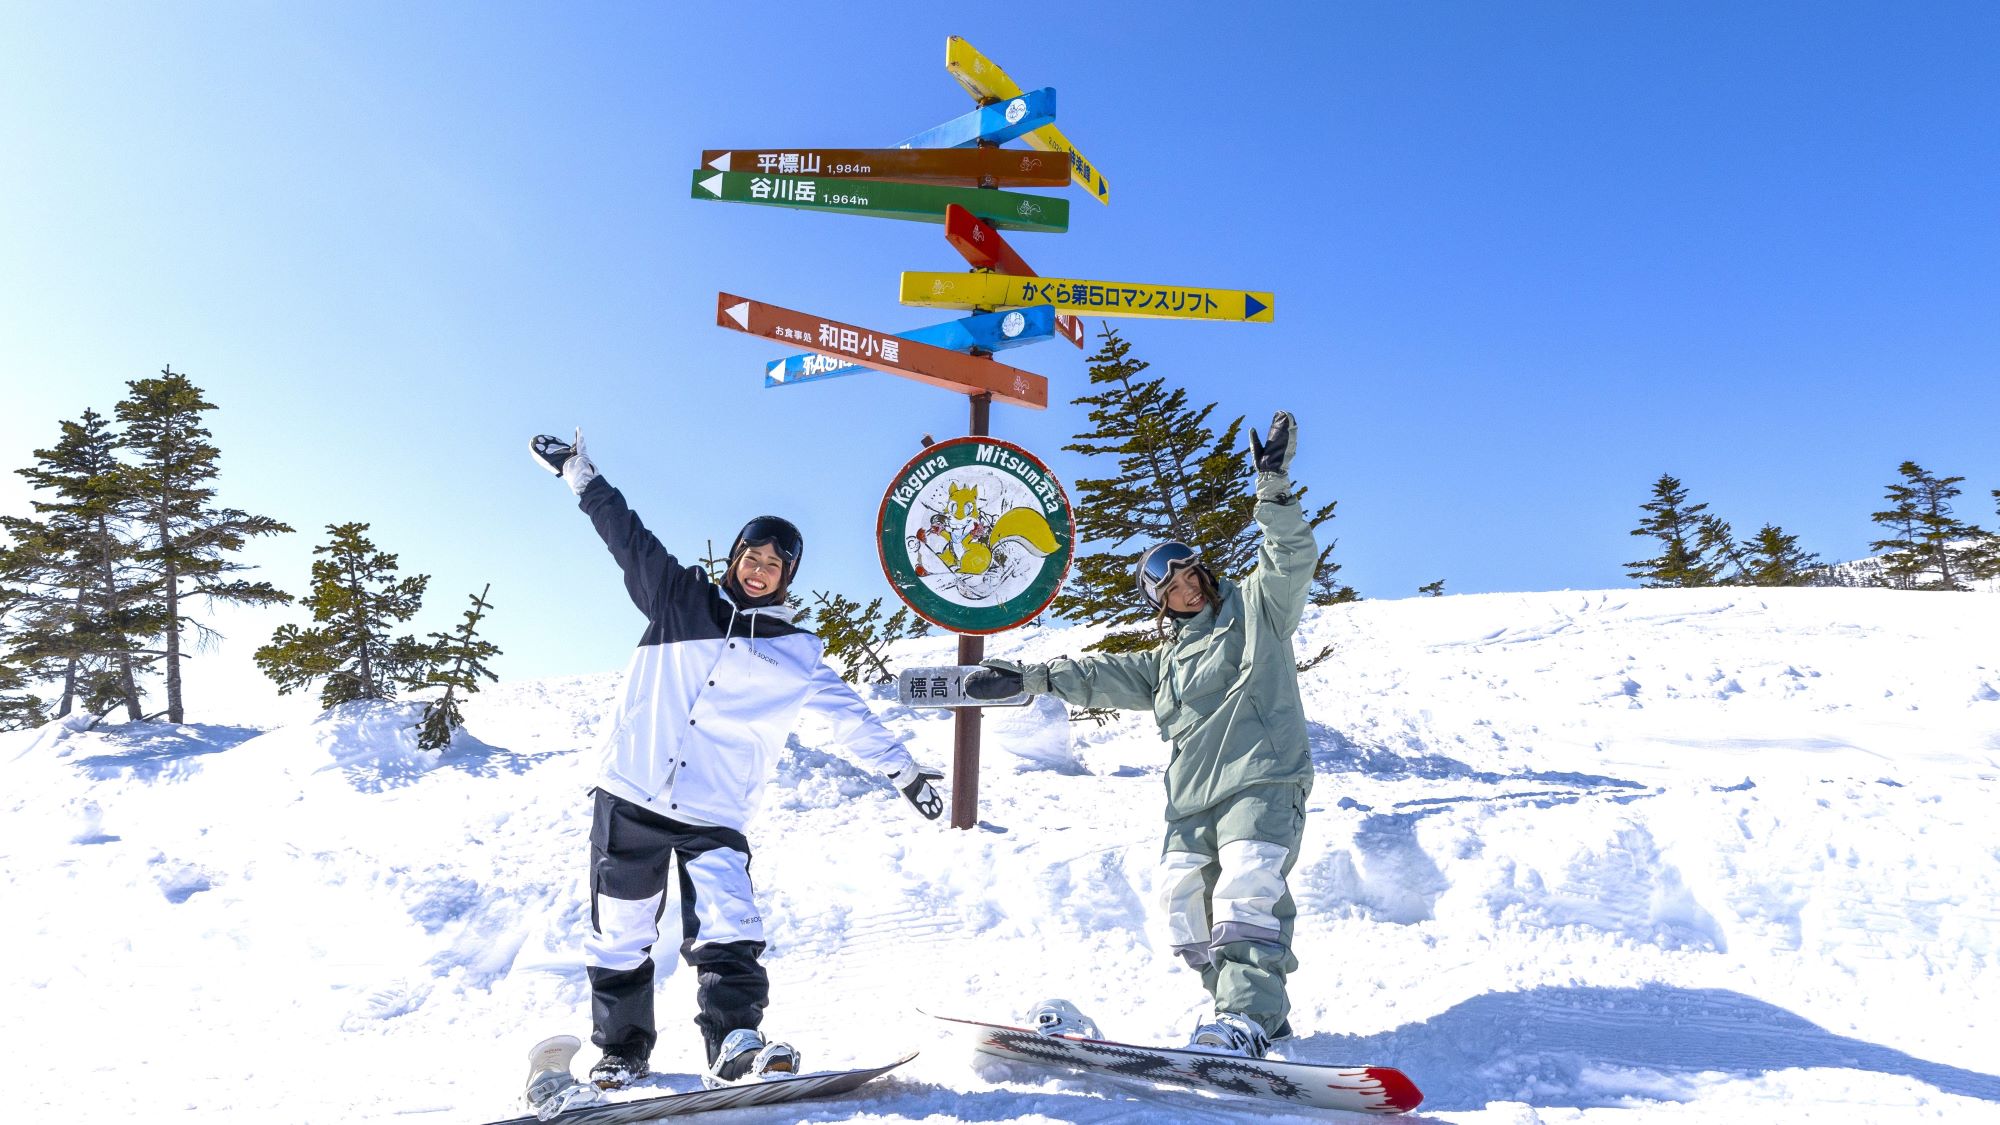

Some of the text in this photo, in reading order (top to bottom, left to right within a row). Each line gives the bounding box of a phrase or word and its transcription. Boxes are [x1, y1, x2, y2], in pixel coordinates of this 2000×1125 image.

[757, 152, 871, 175] 平標山 1,984m
[750, 177, 869, 206] 谷川岳 1,964m
[1022, 281, 1218, 314] かぐら第5ロマンスリフト
[775, 323, 899, 363] お食事処 和田小屋
[891, 443, 1061, 513] Kagura Mitsumata
[757, 652, 779, 667] SOCIETY
